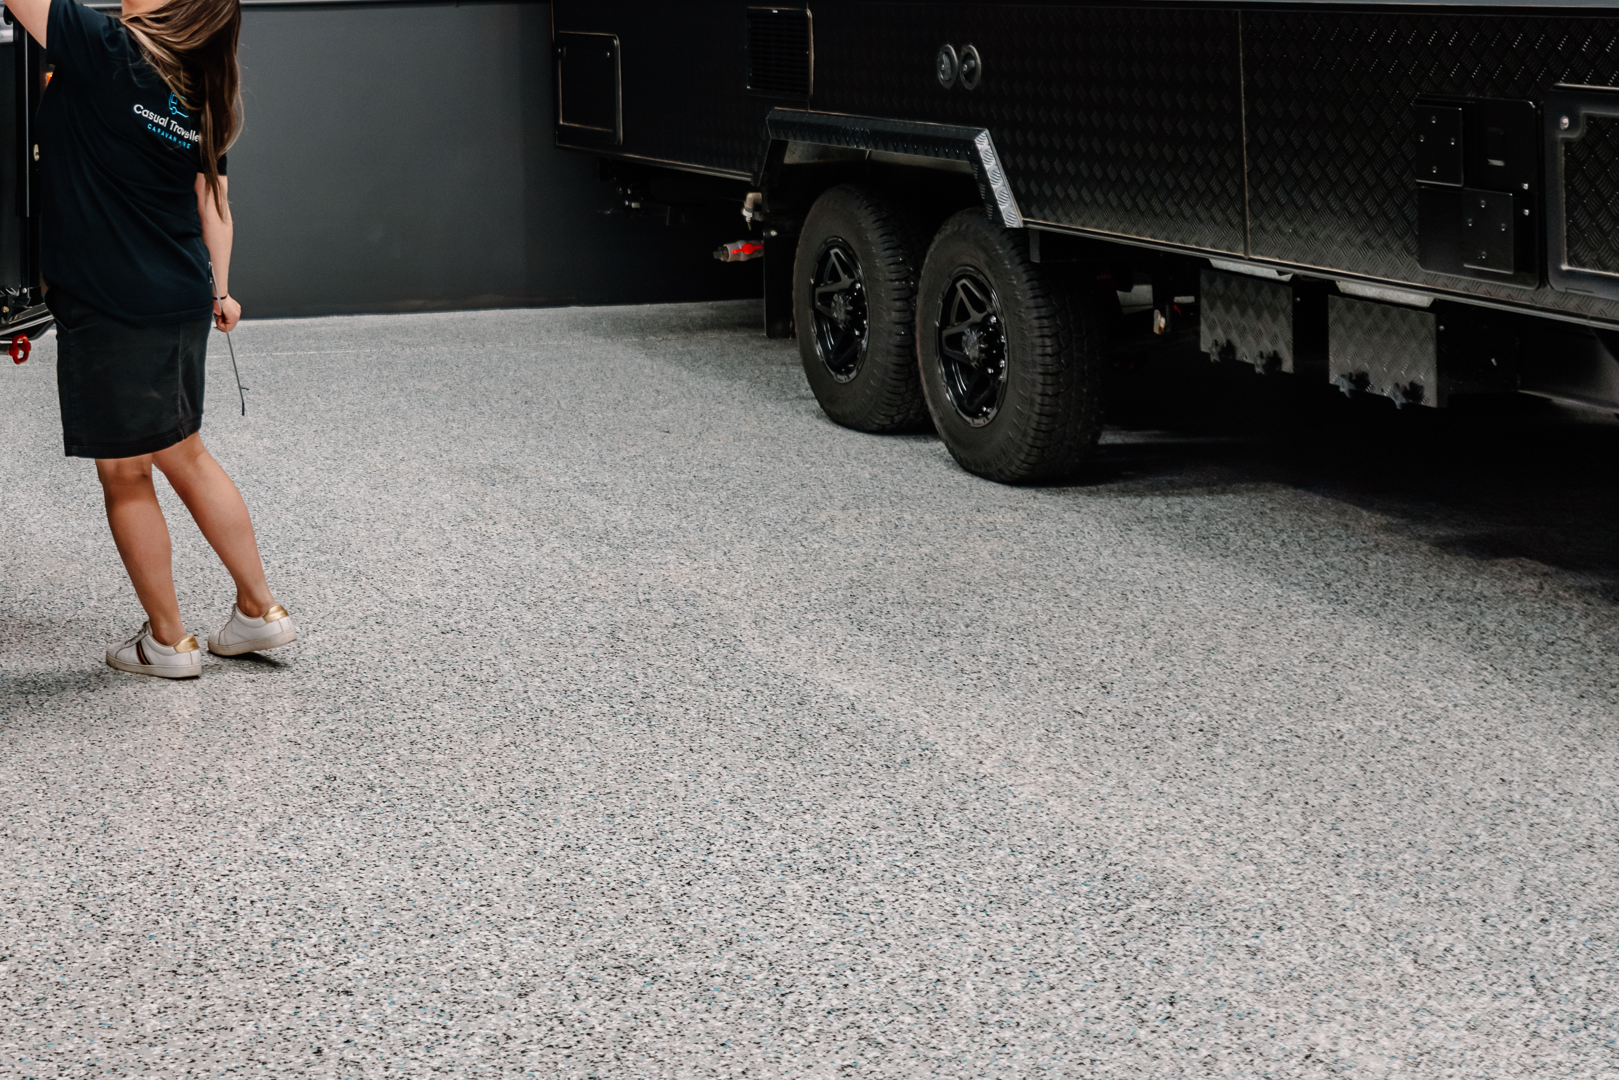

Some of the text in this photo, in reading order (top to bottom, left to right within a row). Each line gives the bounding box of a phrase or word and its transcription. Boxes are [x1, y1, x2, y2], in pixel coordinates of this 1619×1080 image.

[133, 104, 201, 142] Casual Travelle
[147, 123, 177, 142] CARAVAN
